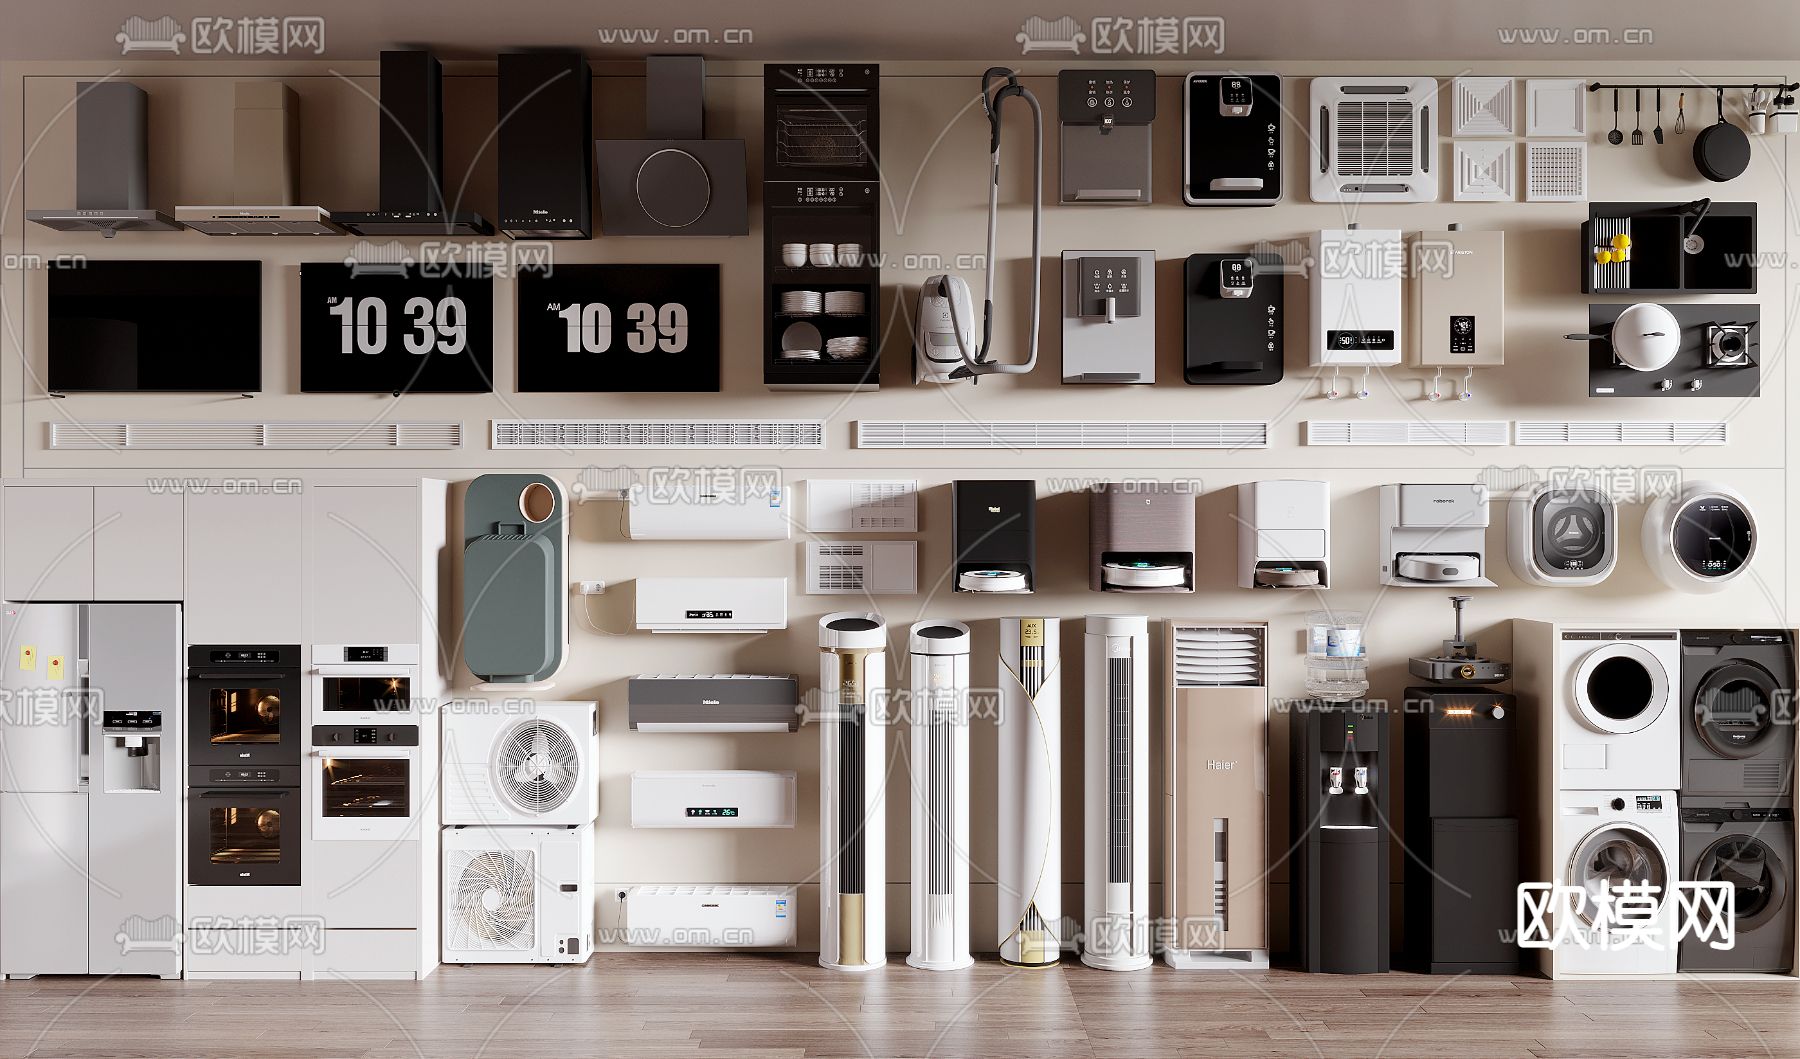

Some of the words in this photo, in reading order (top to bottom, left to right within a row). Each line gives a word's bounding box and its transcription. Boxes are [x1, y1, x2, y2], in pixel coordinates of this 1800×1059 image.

[327, 296, 338, 305] AM
[329, 296, 387, 355] 10
[403, 296, 467, 355] 39
[546, 303, 561, 311] AM
[559, 302, 612, 353] 10
[626, 302, 688, 353] 39
[1207, 758, 1234, 770] Haier
